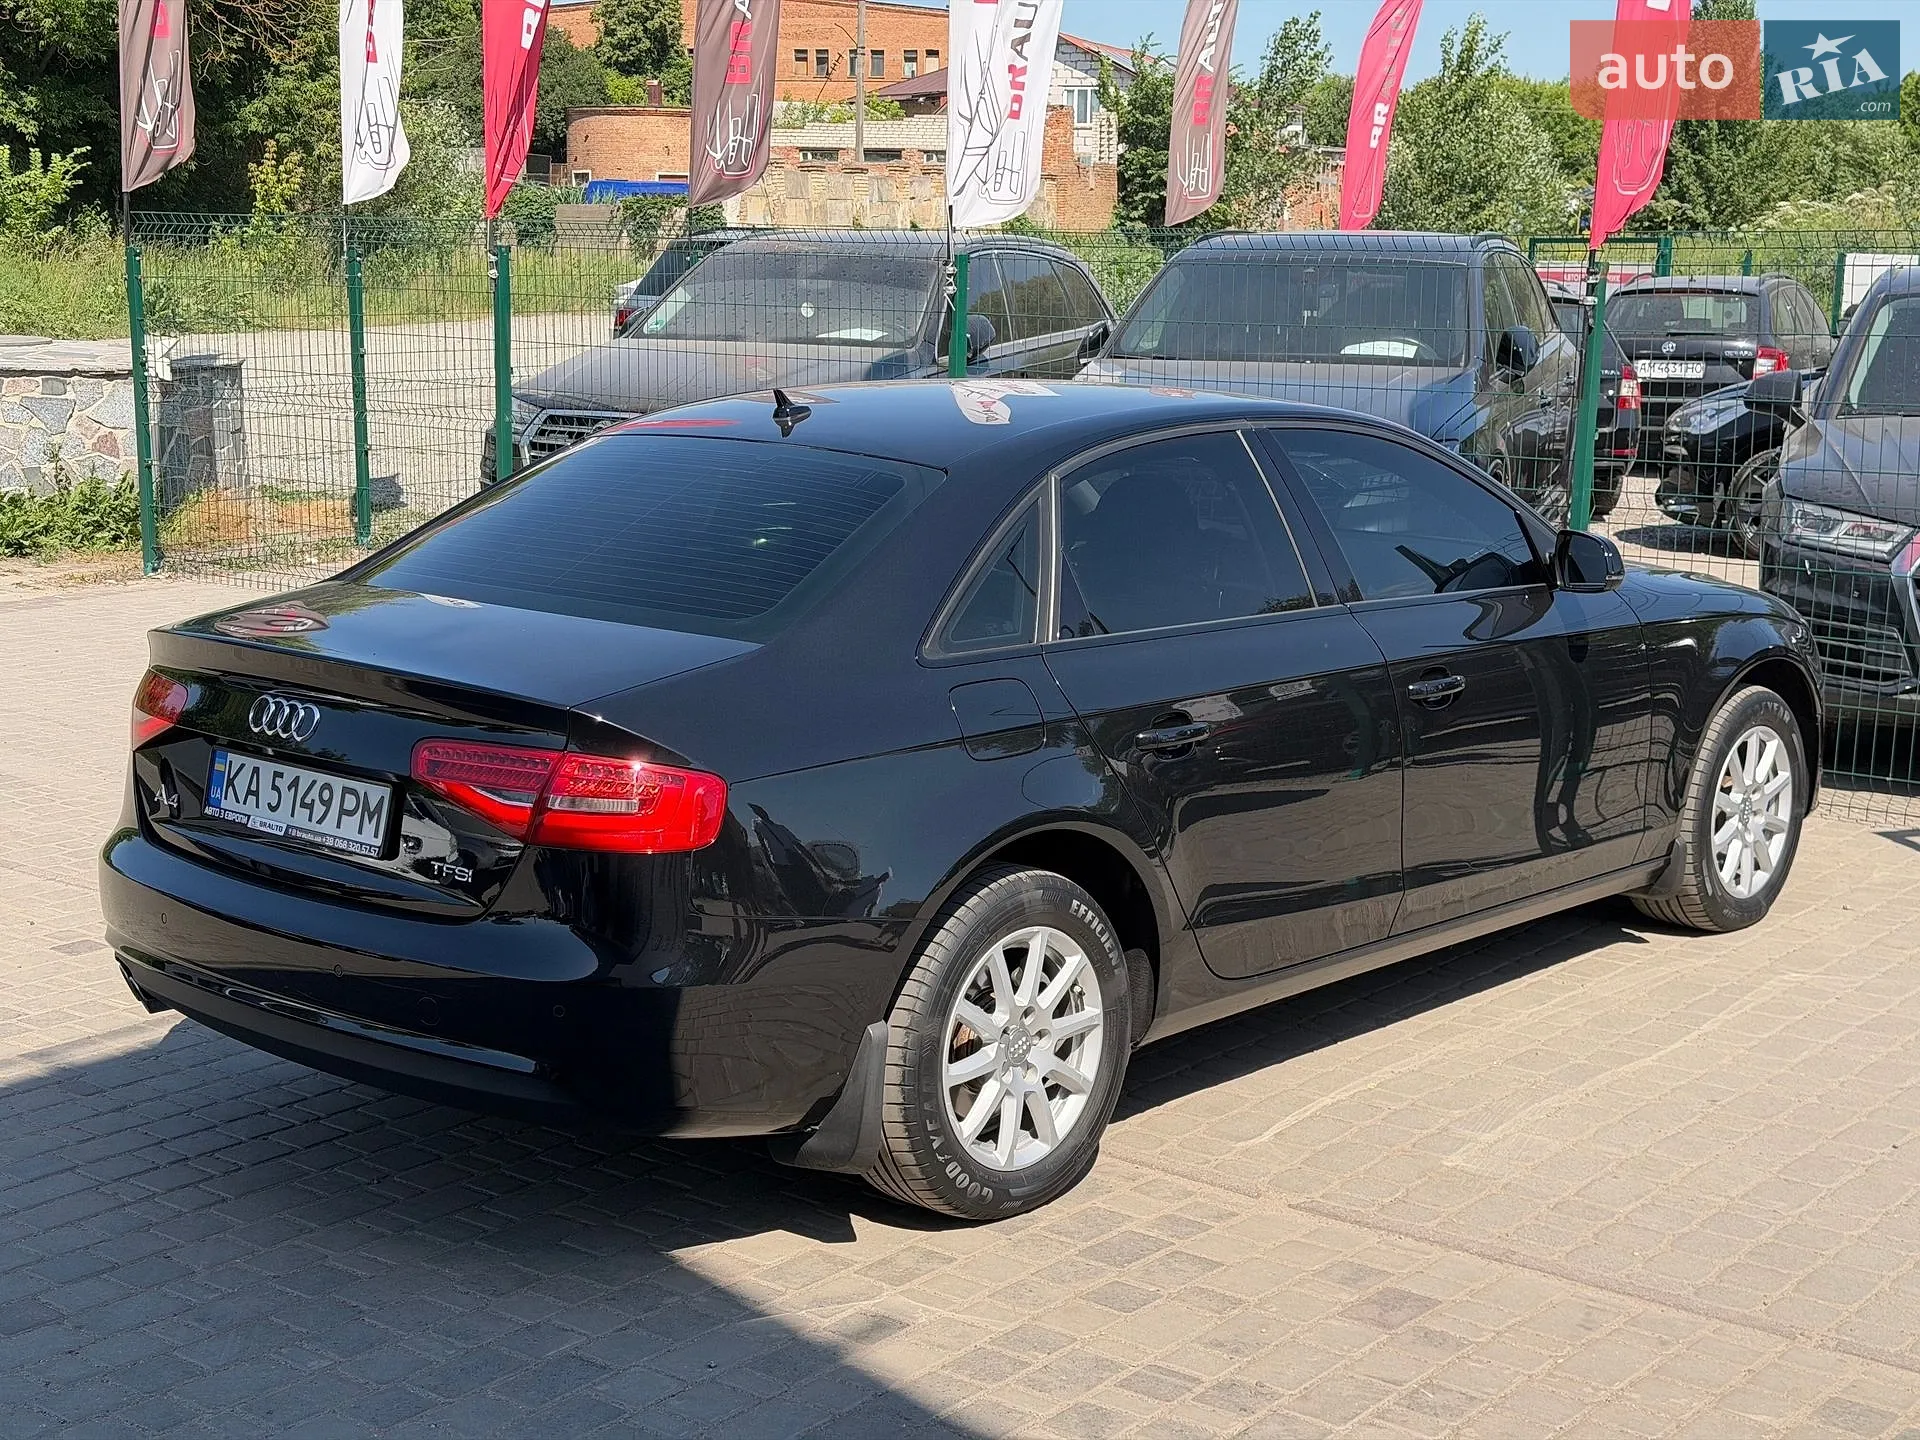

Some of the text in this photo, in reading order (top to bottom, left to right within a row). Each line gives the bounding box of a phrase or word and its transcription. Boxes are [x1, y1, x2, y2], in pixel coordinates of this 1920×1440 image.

[154, 783, 179, 809] A4
[210, 785, 222, 800] UA
[259, 820, 284, 833] BRAUTO
[334, 838, 348, 849] 068
[347, 841, 361, 853] 320
[431, 860, 474, 883] TFSI
